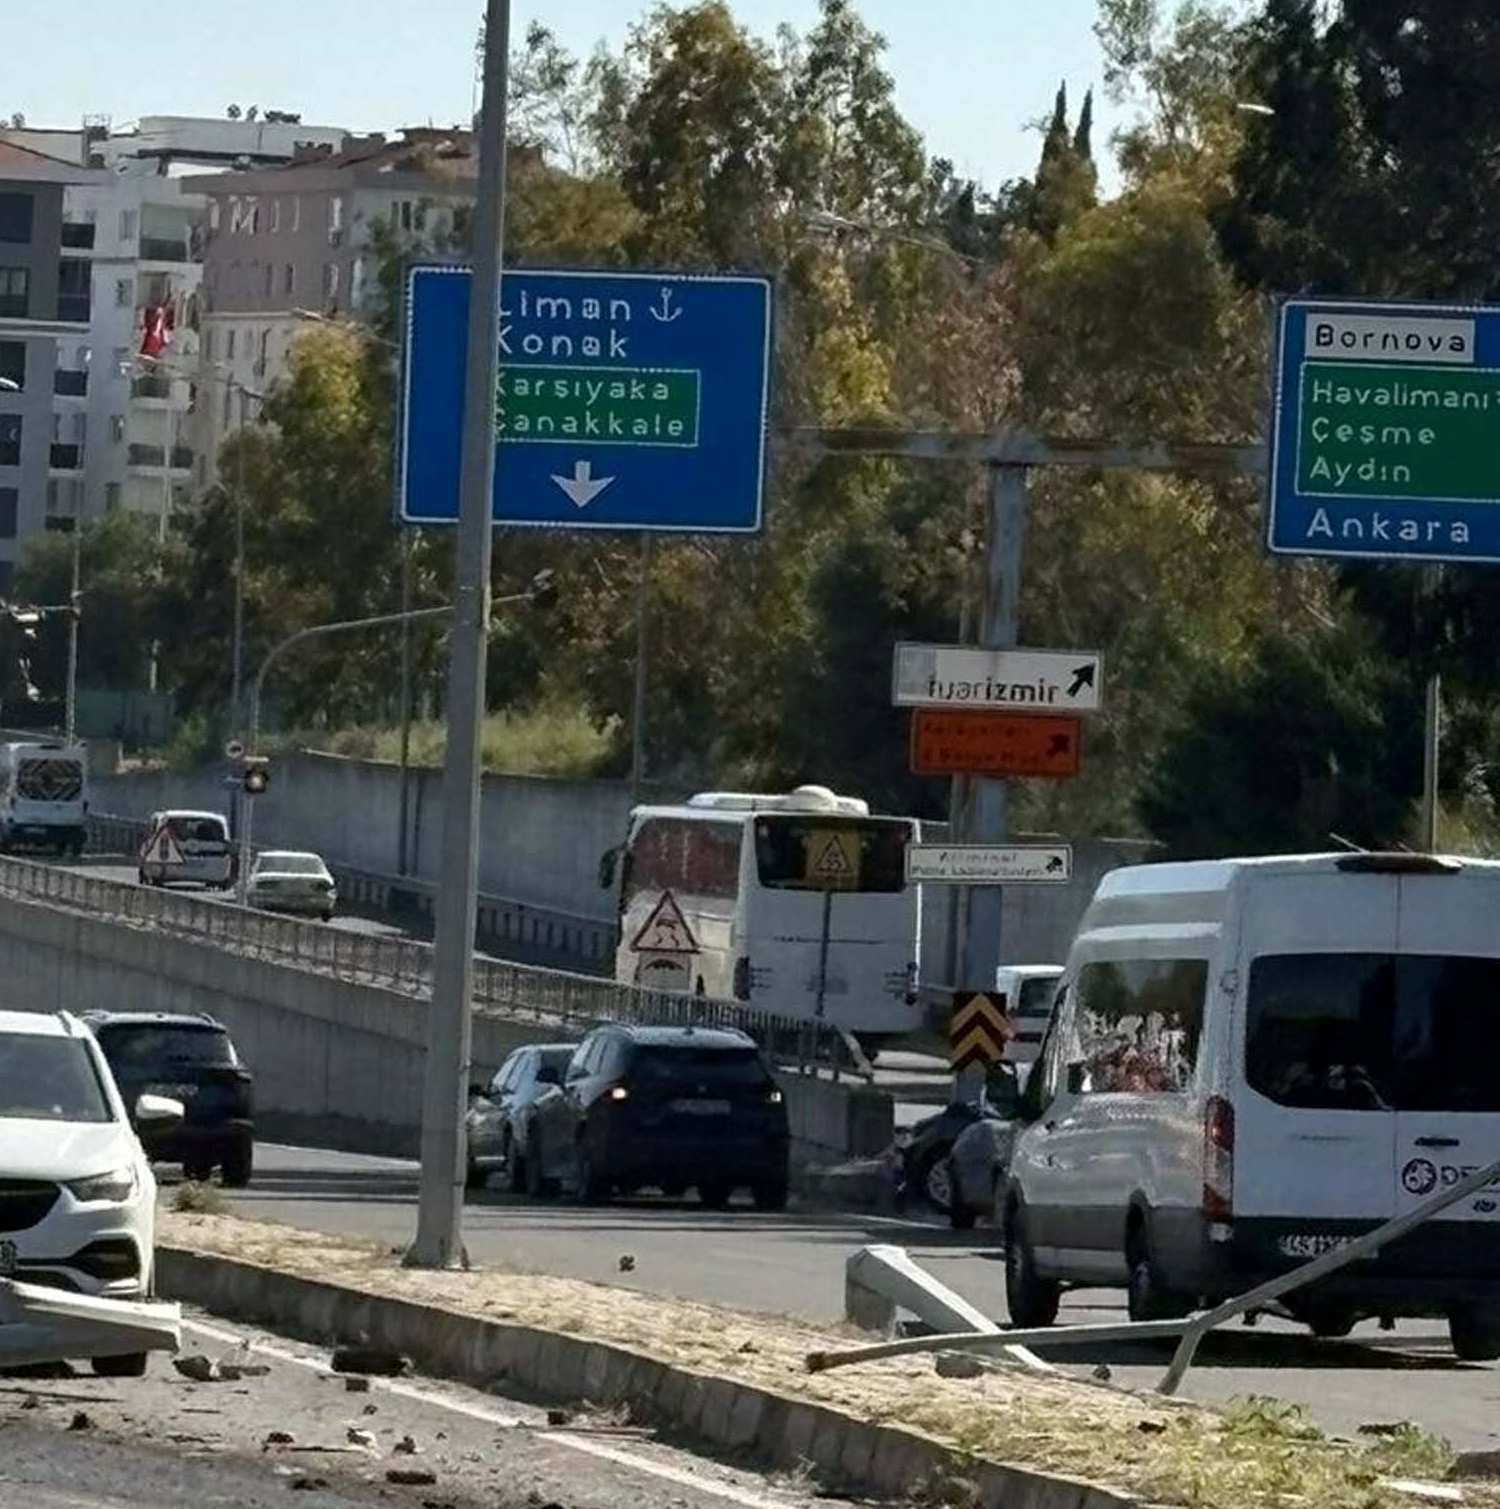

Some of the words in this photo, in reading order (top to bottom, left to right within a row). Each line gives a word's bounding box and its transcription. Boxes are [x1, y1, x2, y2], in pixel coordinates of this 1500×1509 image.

[499, 325, 629, 358] Konak
[1315, 323, 1466, 352] Bornova
[1312, 380, 1488, 410] Havalimanı
[1311, 416, 1436, 444] Çeşme
[1309, 455, 1411, 487] Aydın
[1306, 508, 1470, 544] Ankara
